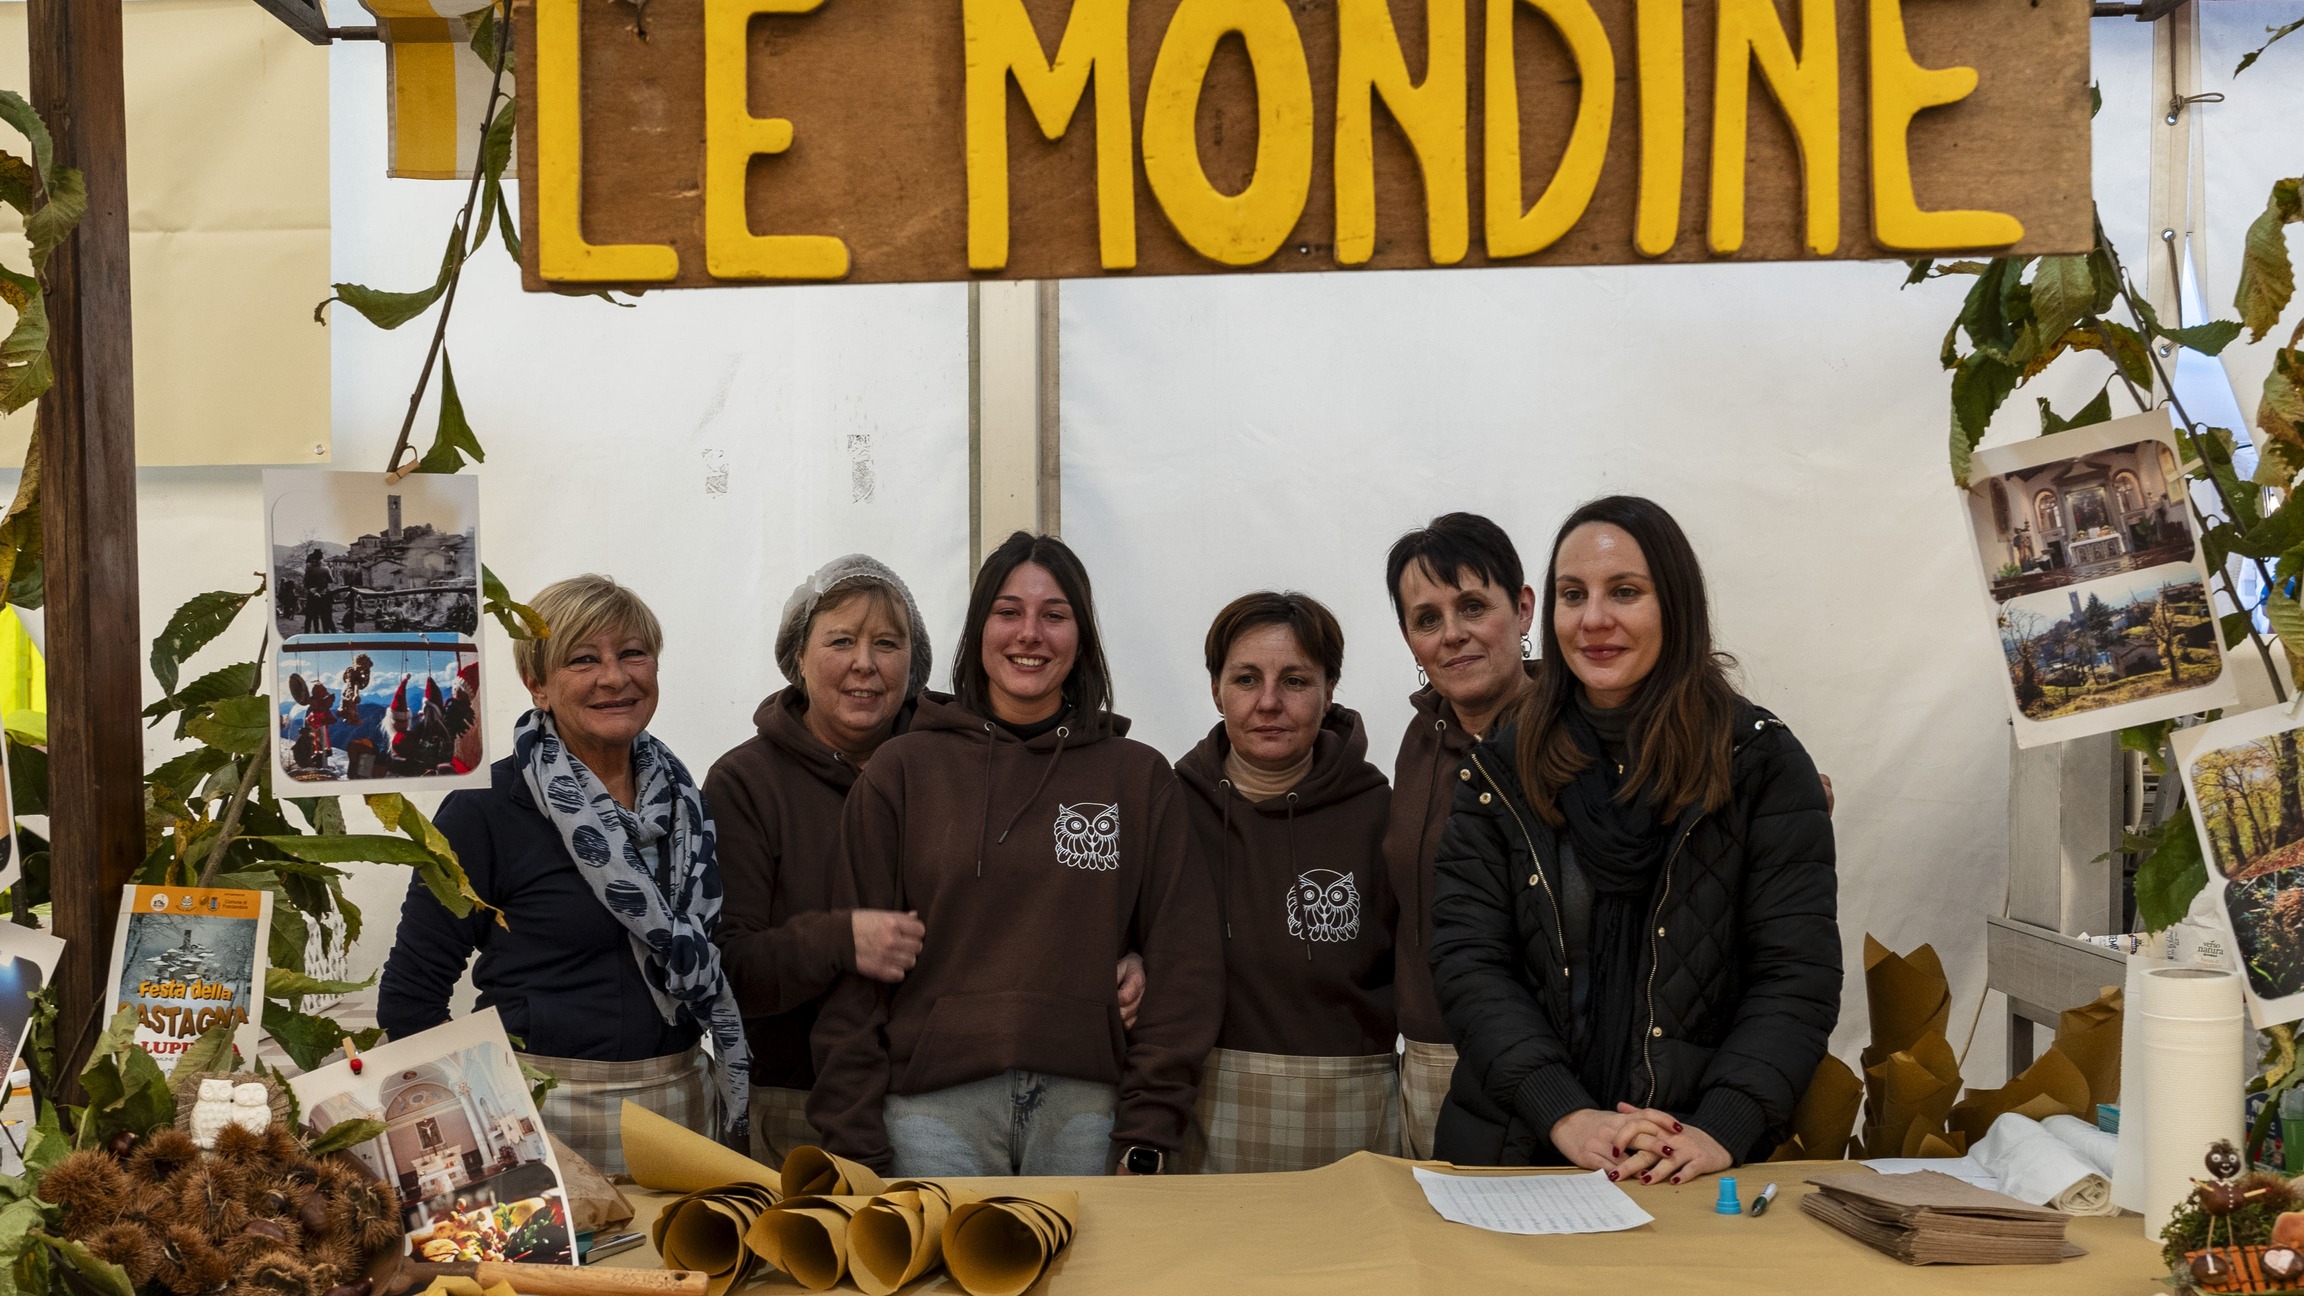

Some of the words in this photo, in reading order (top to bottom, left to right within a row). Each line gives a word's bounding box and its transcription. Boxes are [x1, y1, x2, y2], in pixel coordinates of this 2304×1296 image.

[537, 0, 851, 282] LE
[964, 0, 2024, 270] MONDINE
[139, 979, 187, 999] Festa
[190, 978, 233, 1000] della
